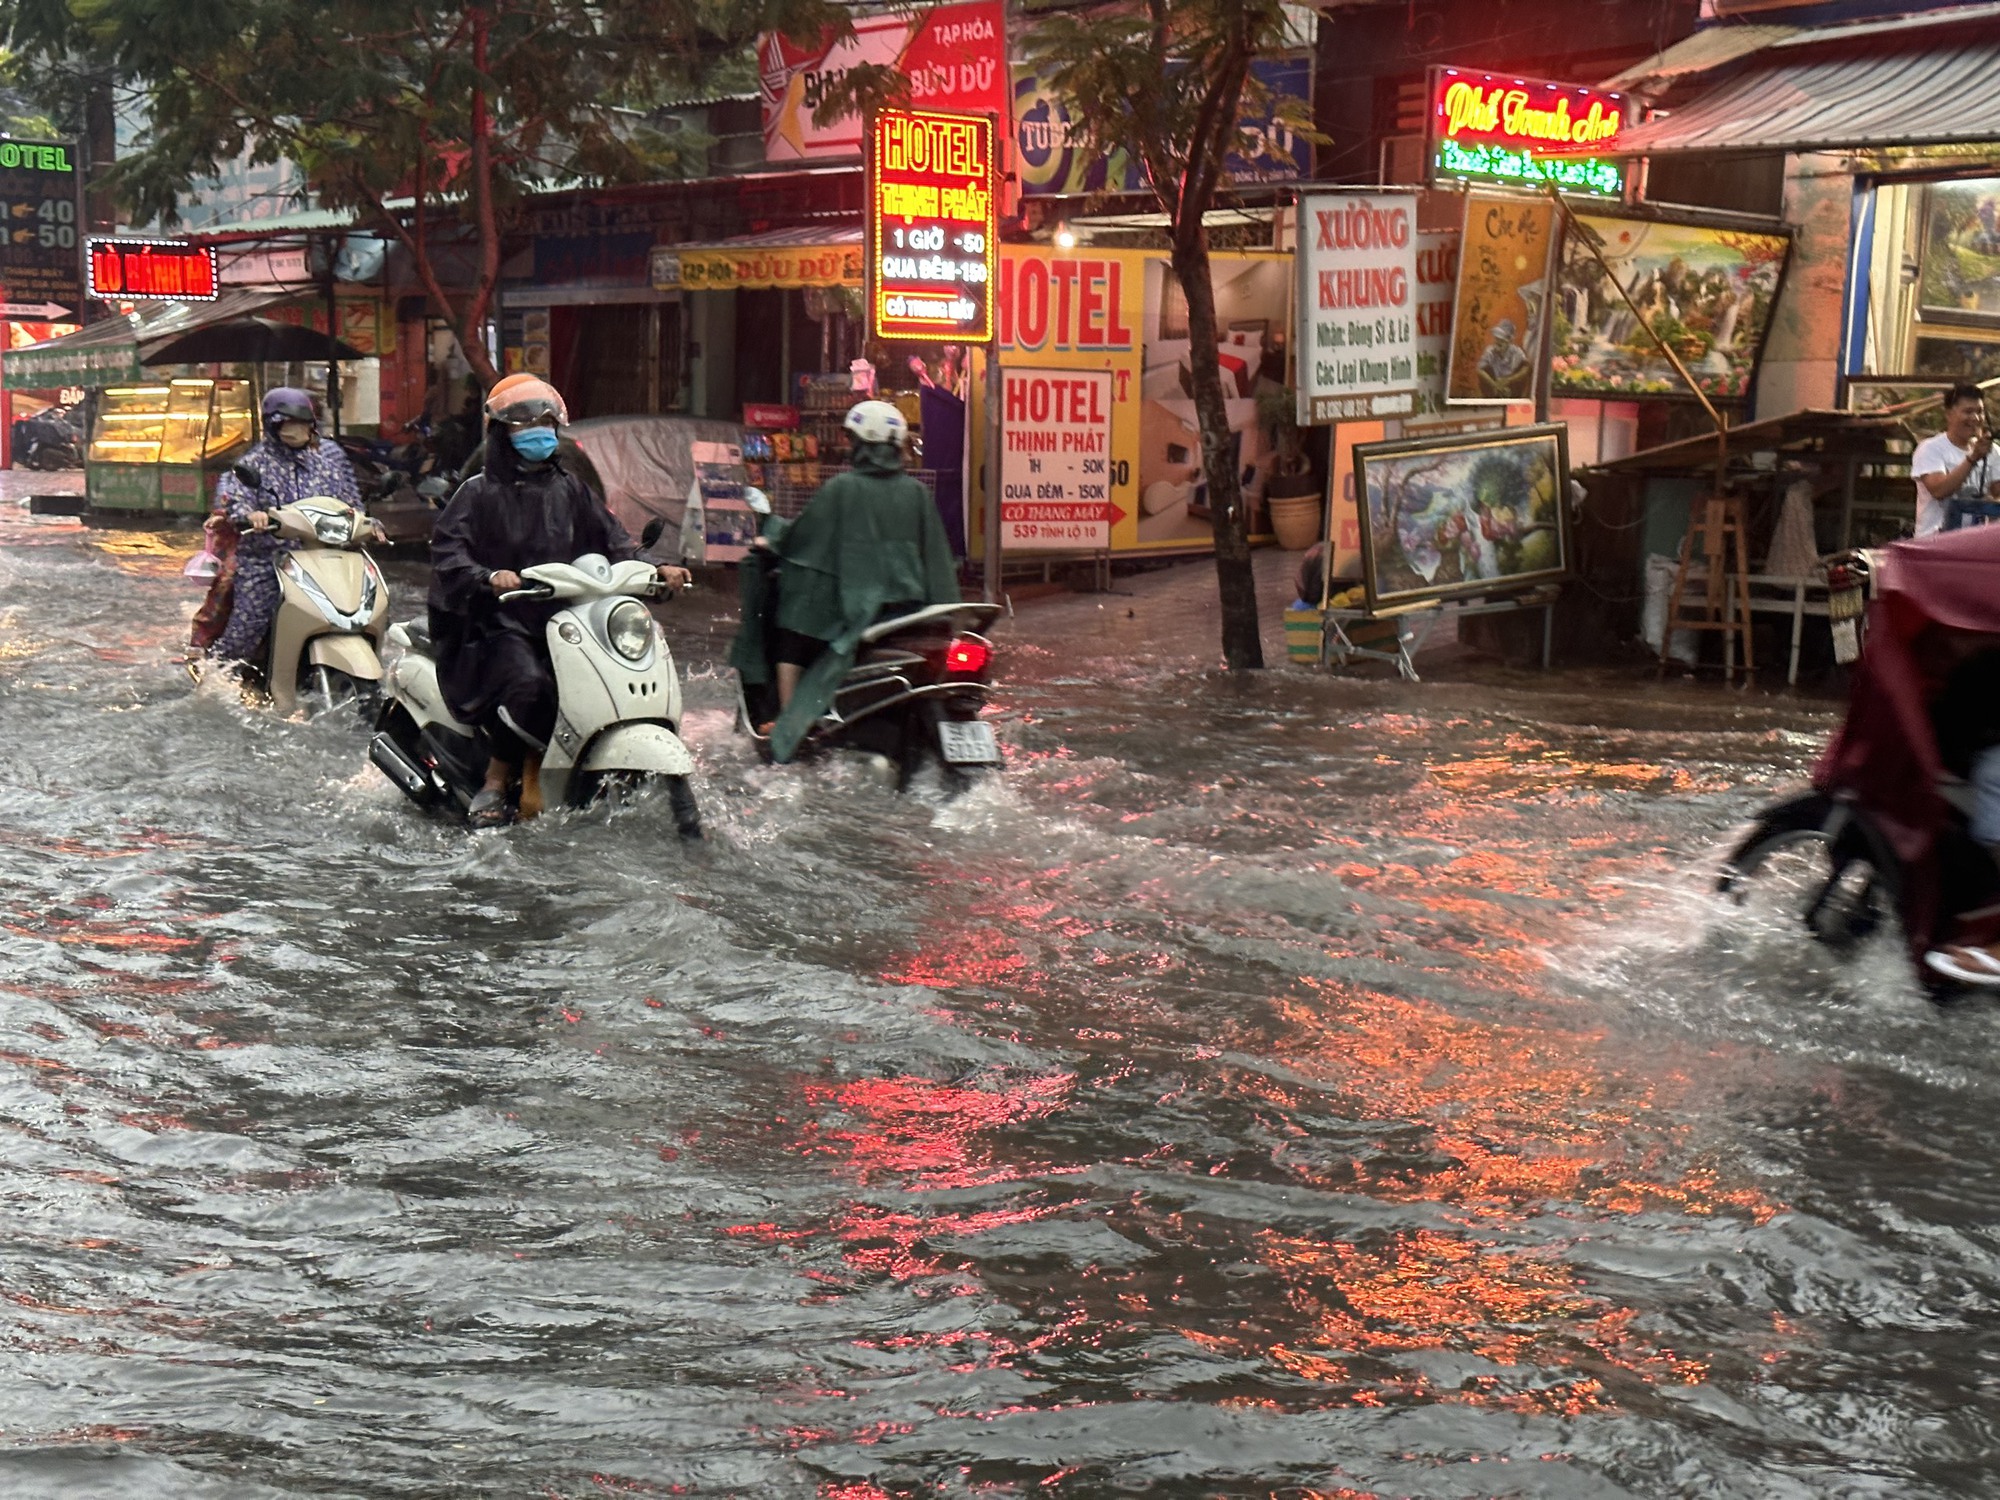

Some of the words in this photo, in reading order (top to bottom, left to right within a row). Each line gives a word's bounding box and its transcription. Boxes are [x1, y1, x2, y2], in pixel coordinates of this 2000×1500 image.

[884, 117, 984, 177] HOTEL
[37, 200, 75, 224] 40
[38, 224, 75, 248] 50
[893, 228, 904, 249] 1
[881, 256, 918, 279] QUA
[1317, 265, 1410, 311] KHUNG
[1006, 378, 1105, 423] HOTEL
[1006, 430, 1057, 456] THỊNH
[1062, 427, 1105, 453] PHÁT
[1082, 458, 1105, 474] 50K
[1004, 484, 1032, 499] QUA
[1036, 481, 1064, 499] ĐÊM
[1078, 484, 1105, 499] 150K
[1013, 524, 1038, 538] 539
[1084, 526, 1097, 538] 10
